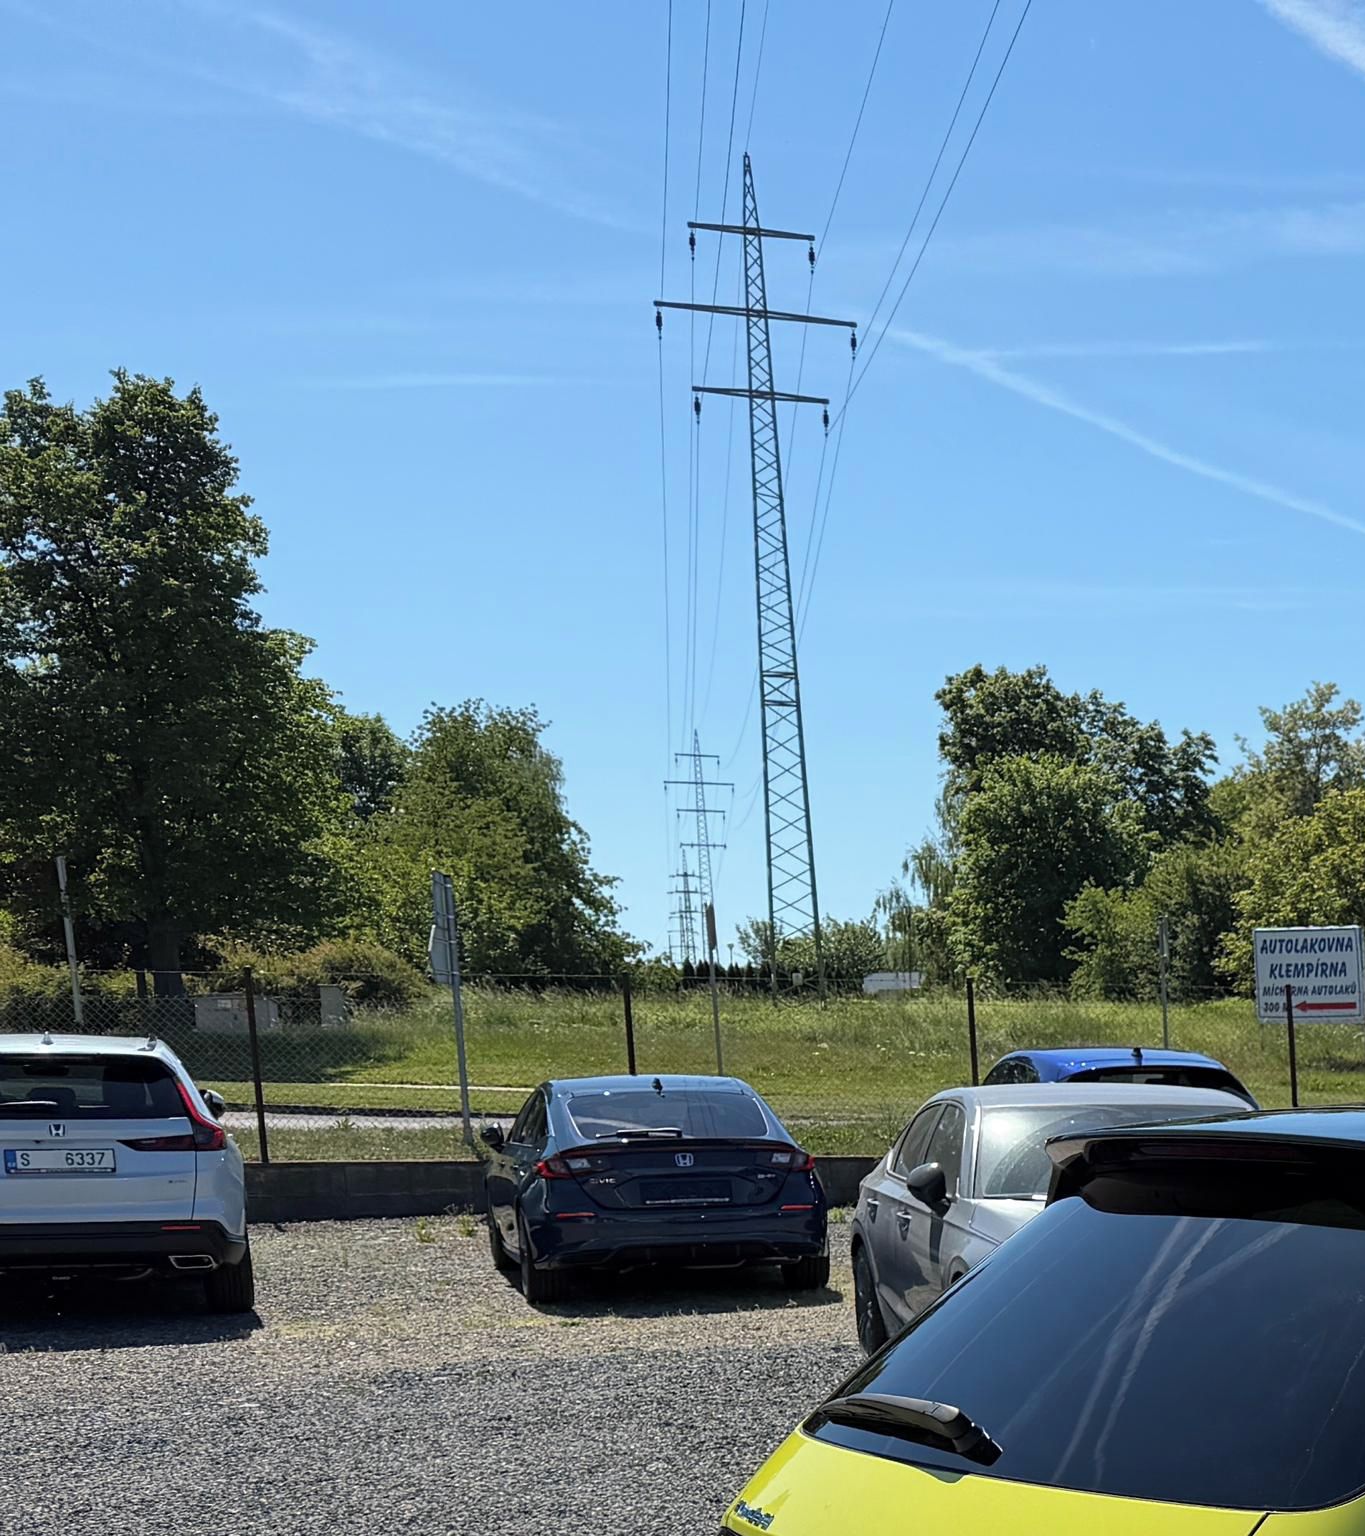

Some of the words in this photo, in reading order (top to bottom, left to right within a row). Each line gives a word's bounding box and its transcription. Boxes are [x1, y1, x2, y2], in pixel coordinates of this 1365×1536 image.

[1260, 936, 1353, 955] AUTOLAKOVNA
[1269, 958, 1347, 980] KLEMPÍRNA
[1262, 984, 1309, 997] MÍCHRNA
[1311, 981, 1357, 996] AUTOLAKŮ
[1263, 1002, 1280, 1013] 300
[20, 1152, 30, 1166] S
[65, 1152, 105, 1166] 6337
